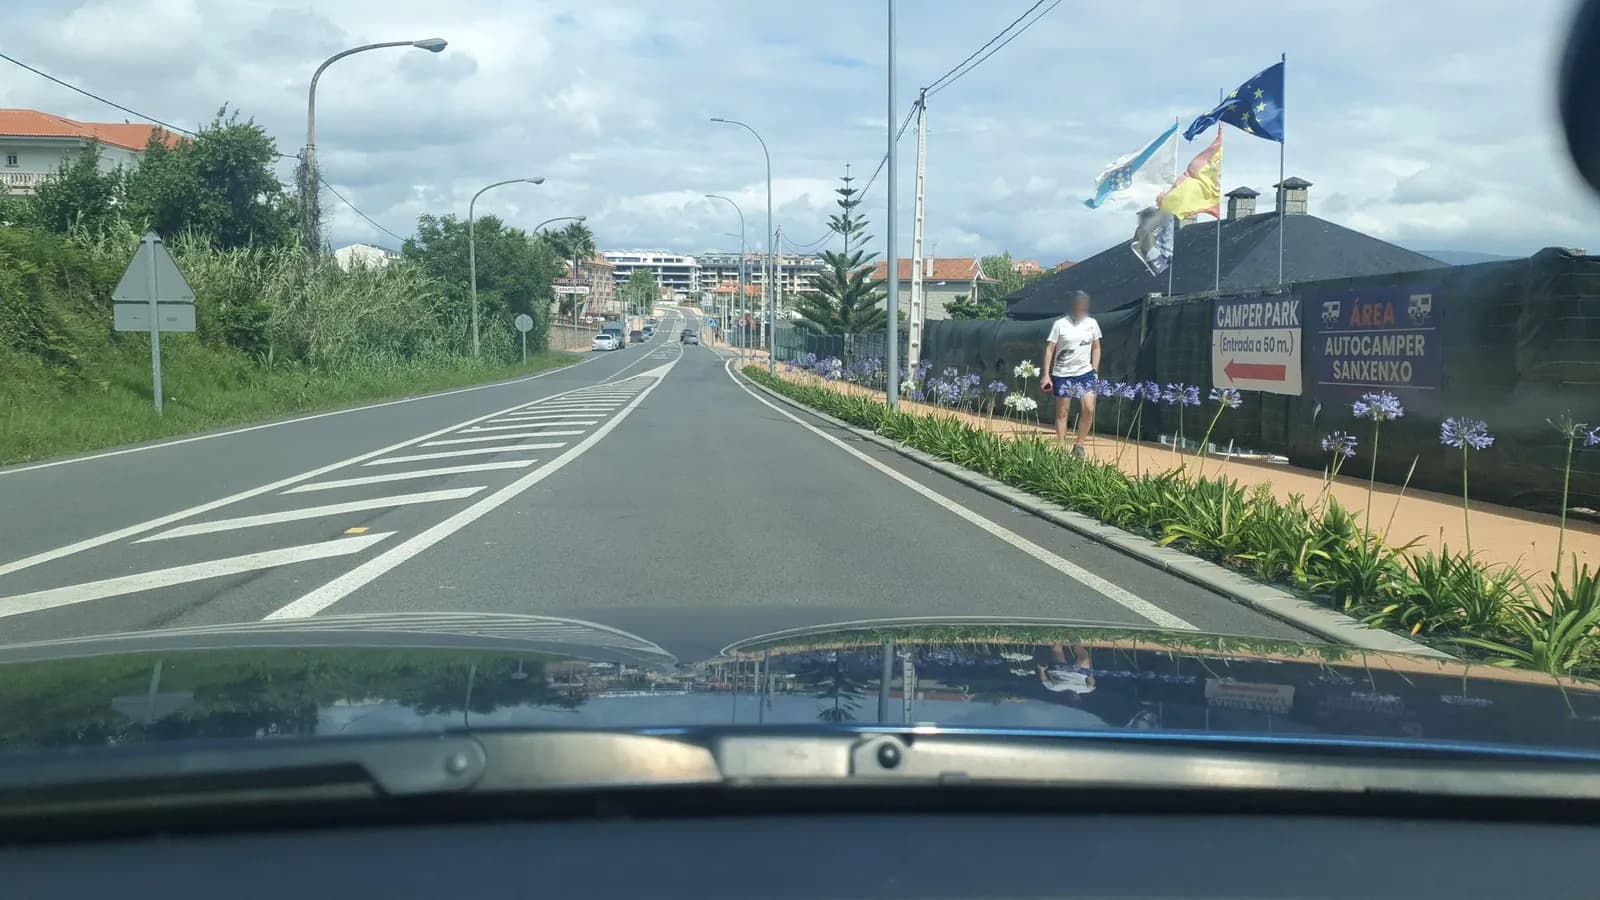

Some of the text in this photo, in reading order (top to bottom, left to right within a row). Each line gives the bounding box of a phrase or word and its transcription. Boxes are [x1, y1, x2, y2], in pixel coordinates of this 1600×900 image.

[1217, 300, 1299, 327] CAMPER PARK
[1350, 297, 1395, 327] ÁREA
[1220, 330, 1293, 356] (Entrada a 50 m.)
[1325, 335, 1425, 356] AUTOCAMPER
[1333, 360, 1412, 382] SANXENXO
